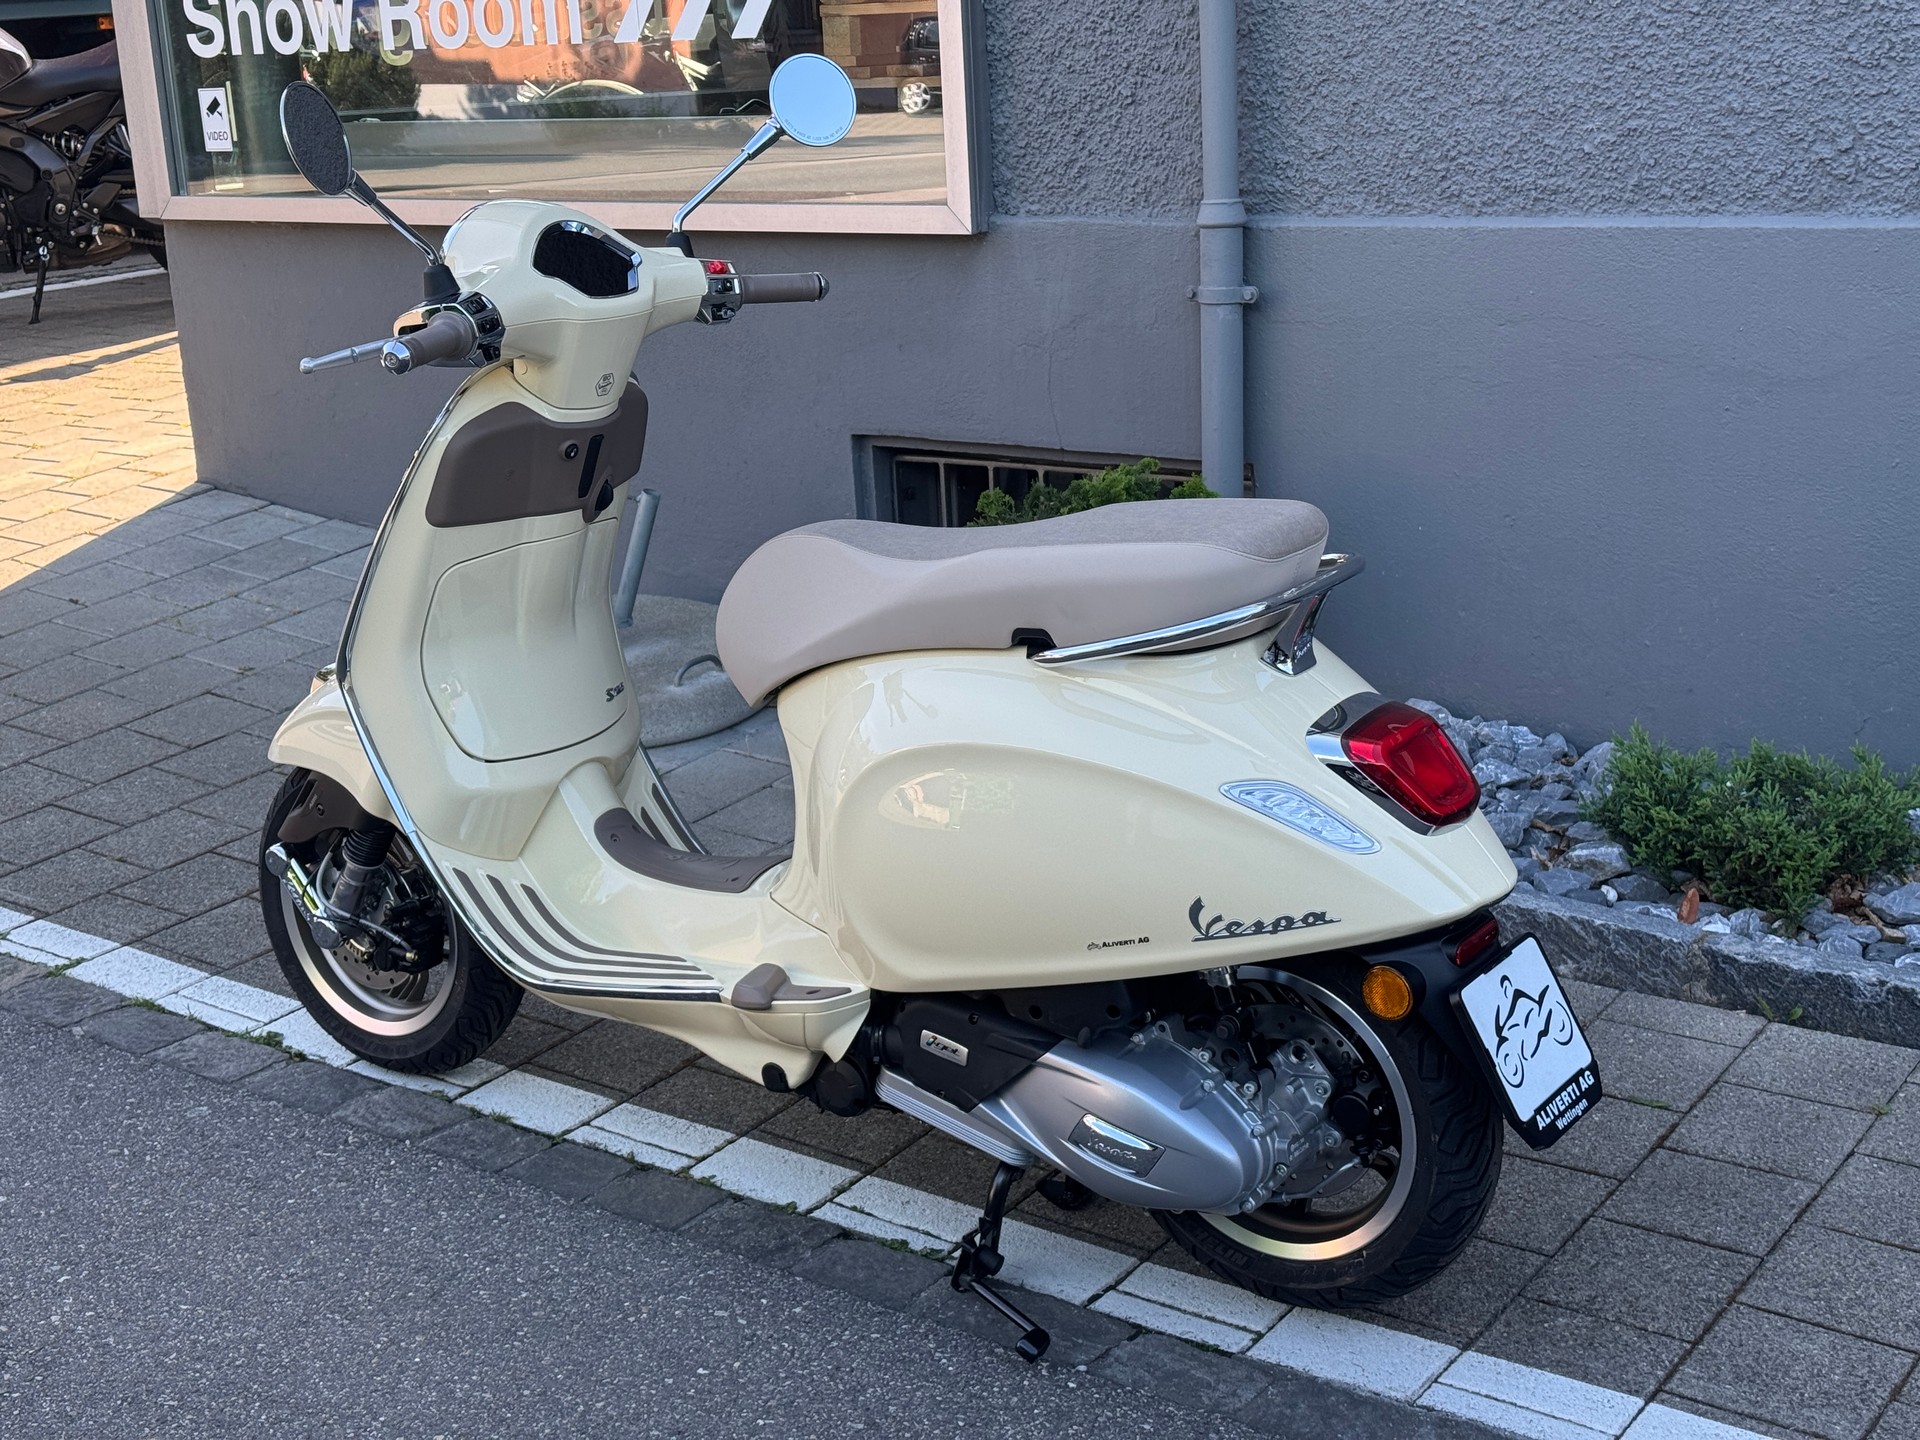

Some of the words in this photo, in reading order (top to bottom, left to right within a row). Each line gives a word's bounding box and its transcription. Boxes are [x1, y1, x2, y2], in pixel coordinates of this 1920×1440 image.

[182, 0, 354, 59] Show
[379, 0, 583, 50] Room
[206, 131, 229, 142] VIDEO
[1189, 896, 1341, 942] Vespa
[1102, 939, 1136, 948] ALIVERTI
[1137, 936, 1150, 944] AG
[1536, 1082, 1580, 1130] ALIVERTI
[1579, 1070, 1594, 1092] AG
[1555, 1098, 1588, 1130] Wettingen
